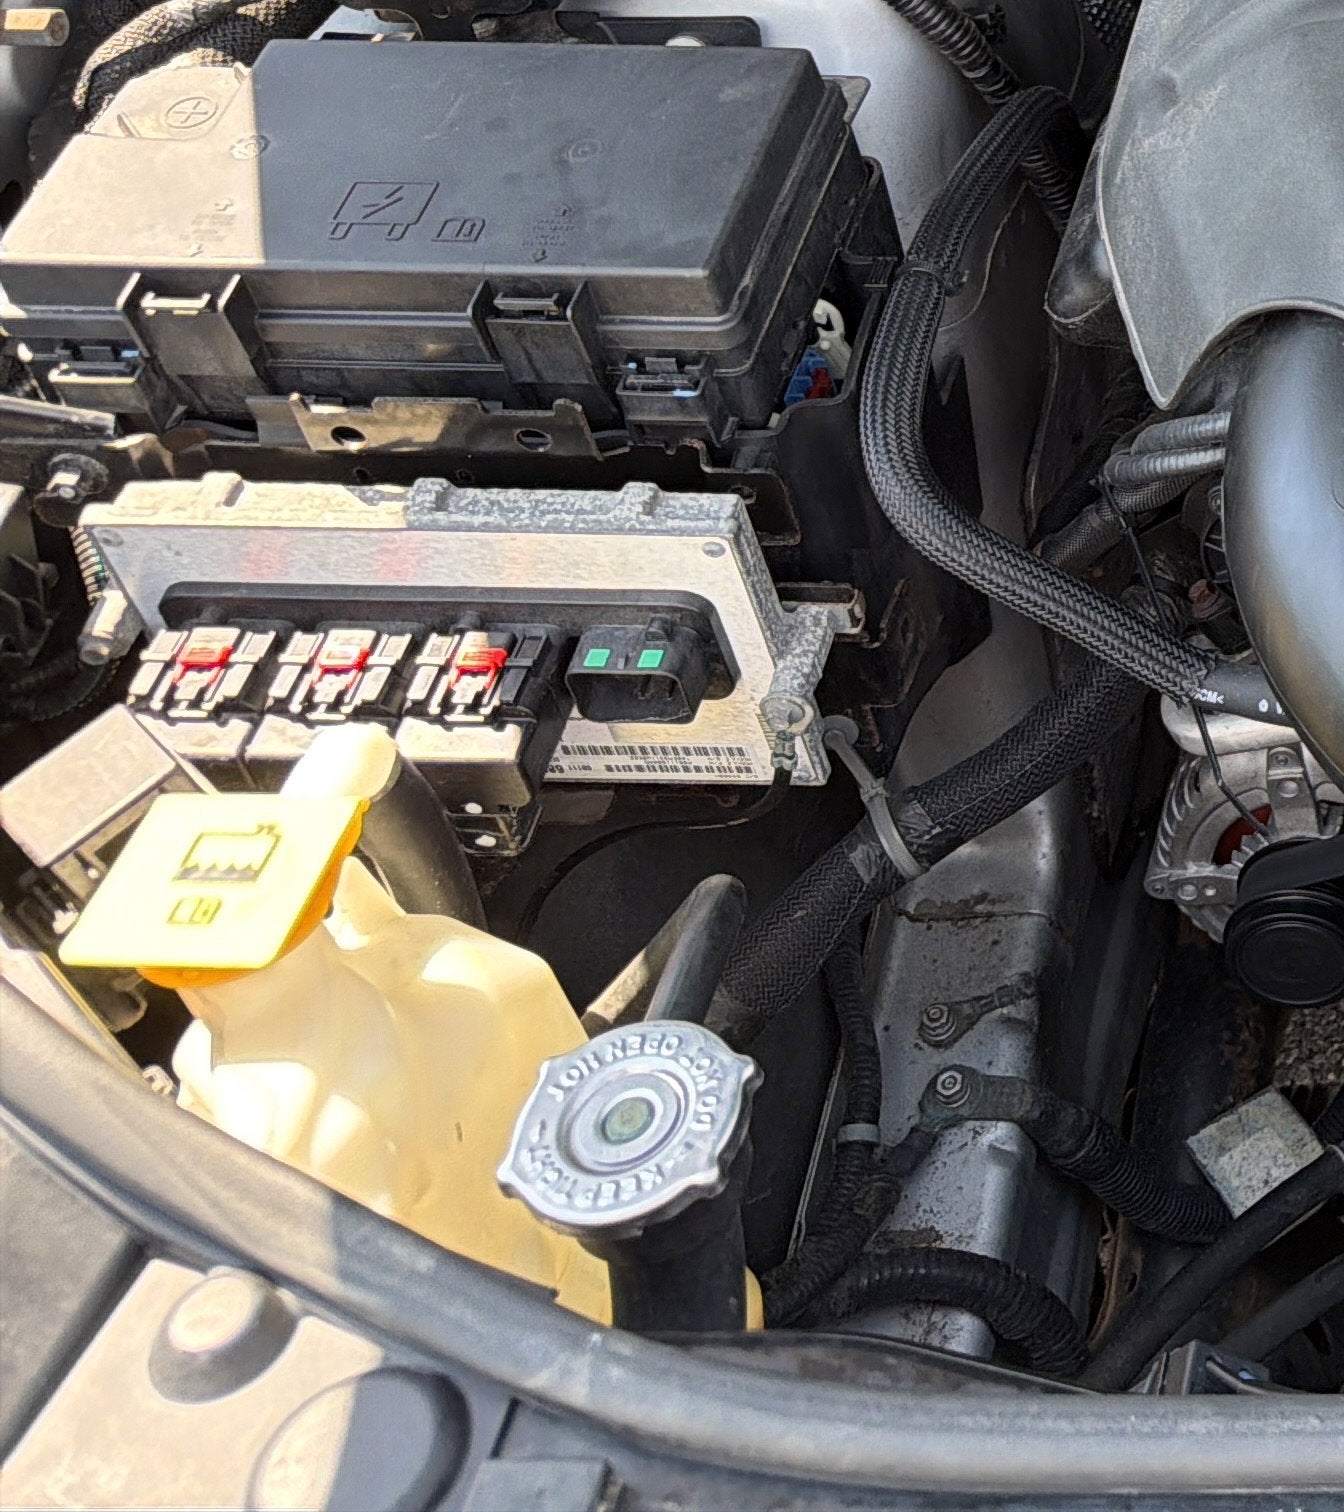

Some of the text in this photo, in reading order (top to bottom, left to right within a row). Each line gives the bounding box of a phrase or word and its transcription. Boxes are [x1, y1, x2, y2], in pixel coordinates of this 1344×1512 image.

[604, 1032, 685, 1064] OPEN
[546, 1051, 602, 1104] HOT
[690, 1094, 720, 1133] DO
[573, 1163, 667, 1210] KEEP
